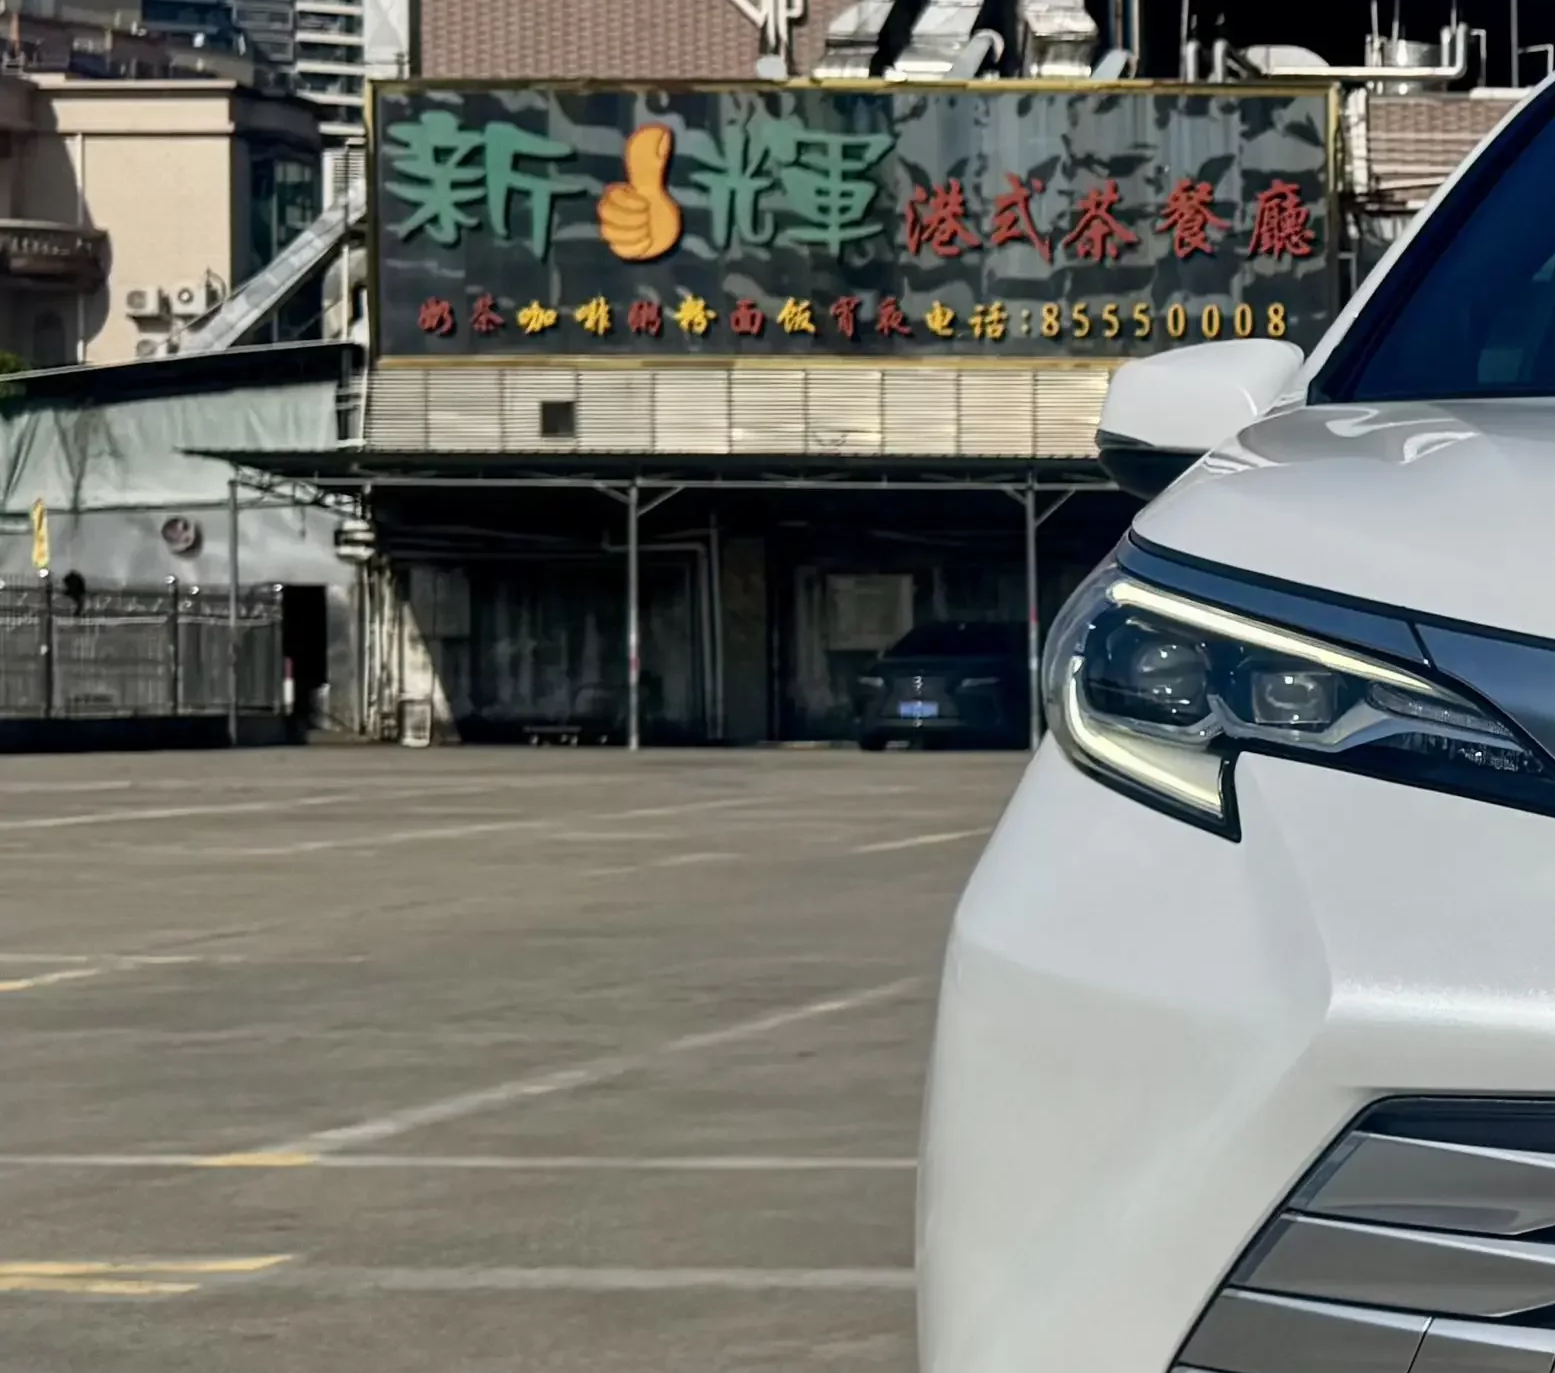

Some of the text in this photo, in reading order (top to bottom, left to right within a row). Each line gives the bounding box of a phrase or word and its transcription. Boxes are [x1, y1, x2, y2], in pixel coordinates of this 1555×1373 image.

[904, 173, 1314, 263] 港式茶餐廳
